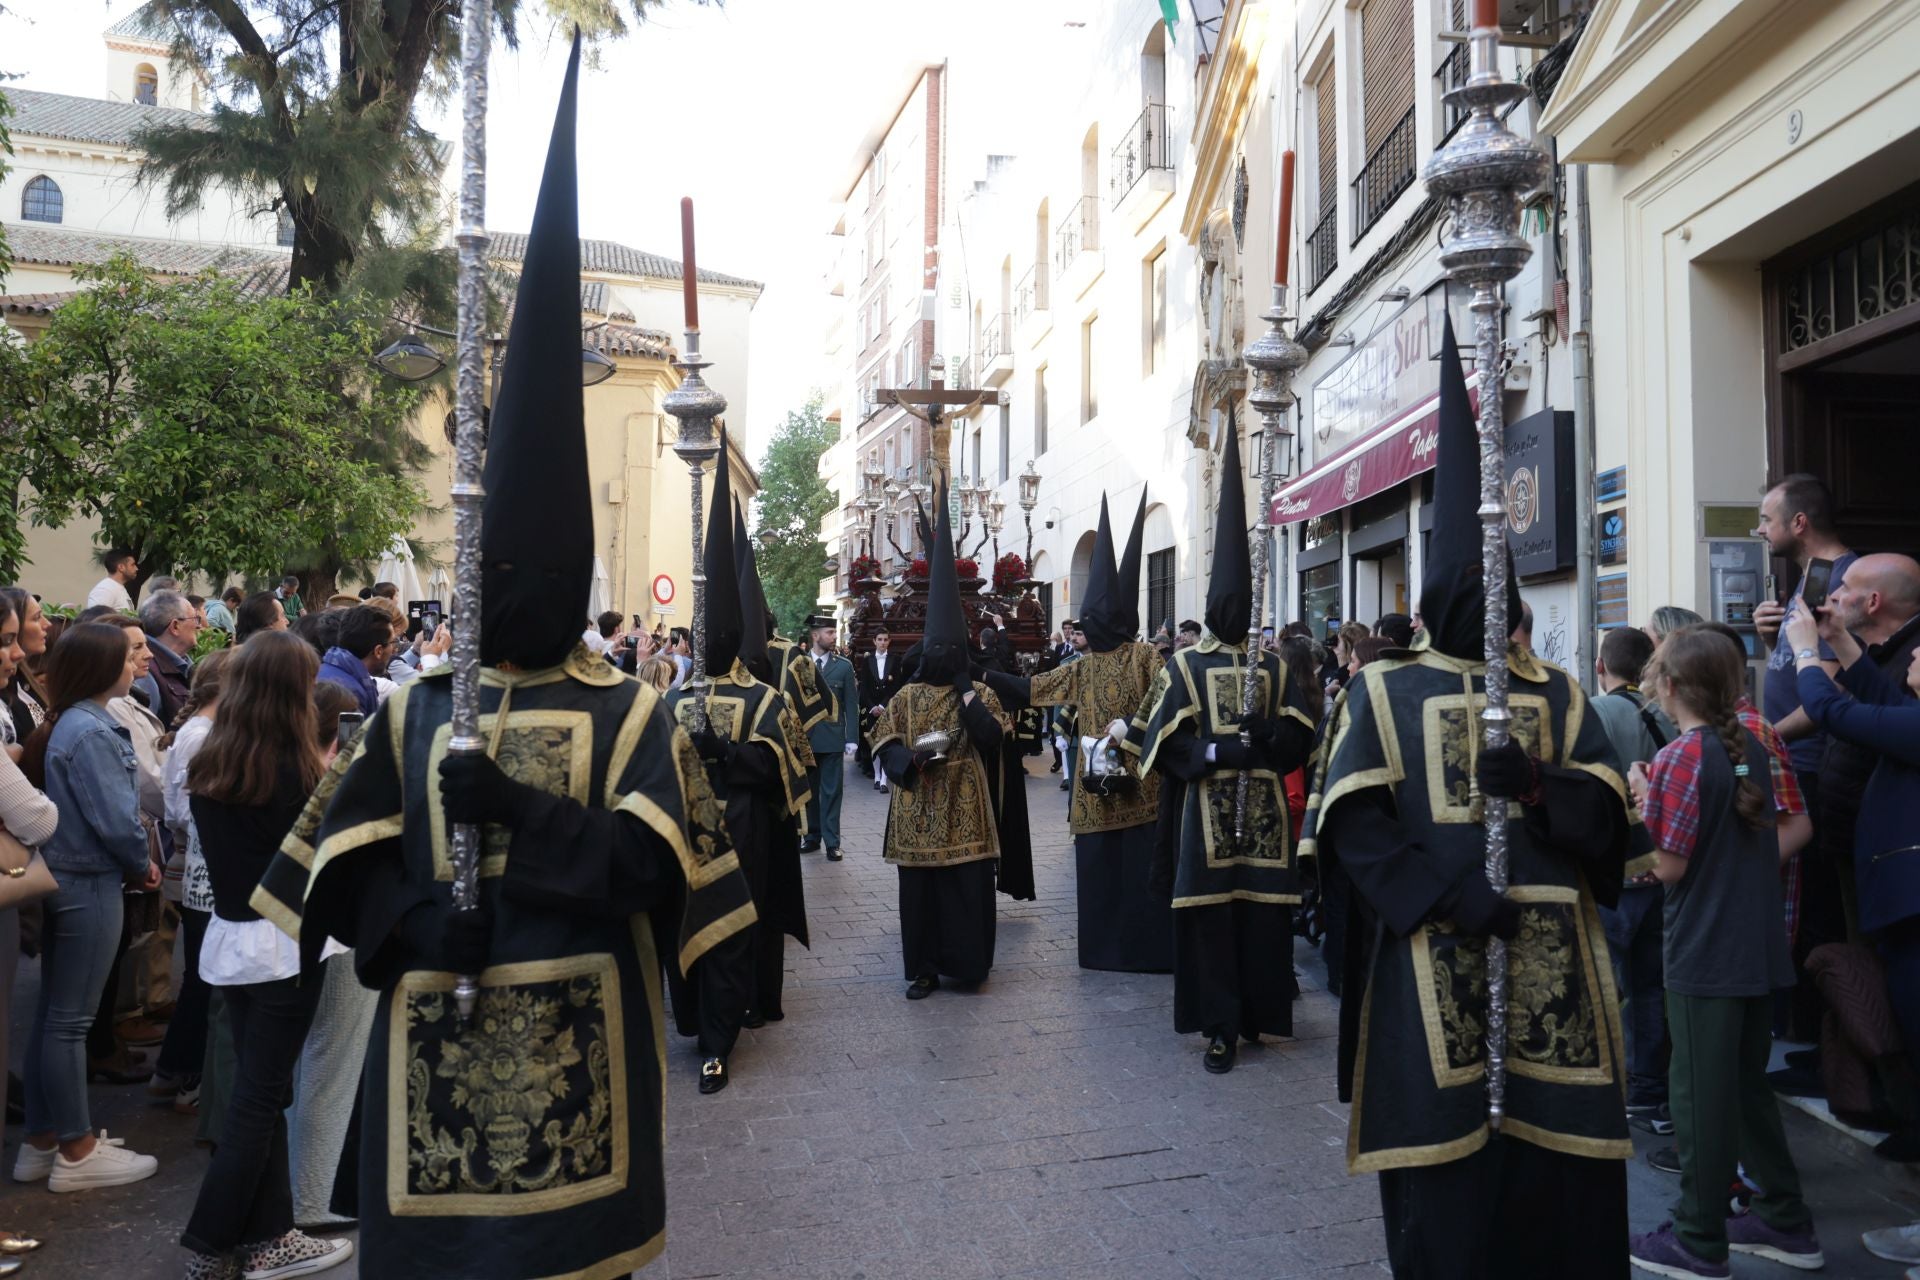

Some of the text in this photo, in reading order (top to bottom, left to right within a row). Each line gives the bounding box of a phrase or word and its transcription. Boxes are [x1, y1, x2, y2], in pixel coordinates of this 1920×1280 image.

[1787, 109, 1803, 145] 9
[1394, 316, 1428, 379] Sur
[1409, 428, 1439, 462] Tapa
